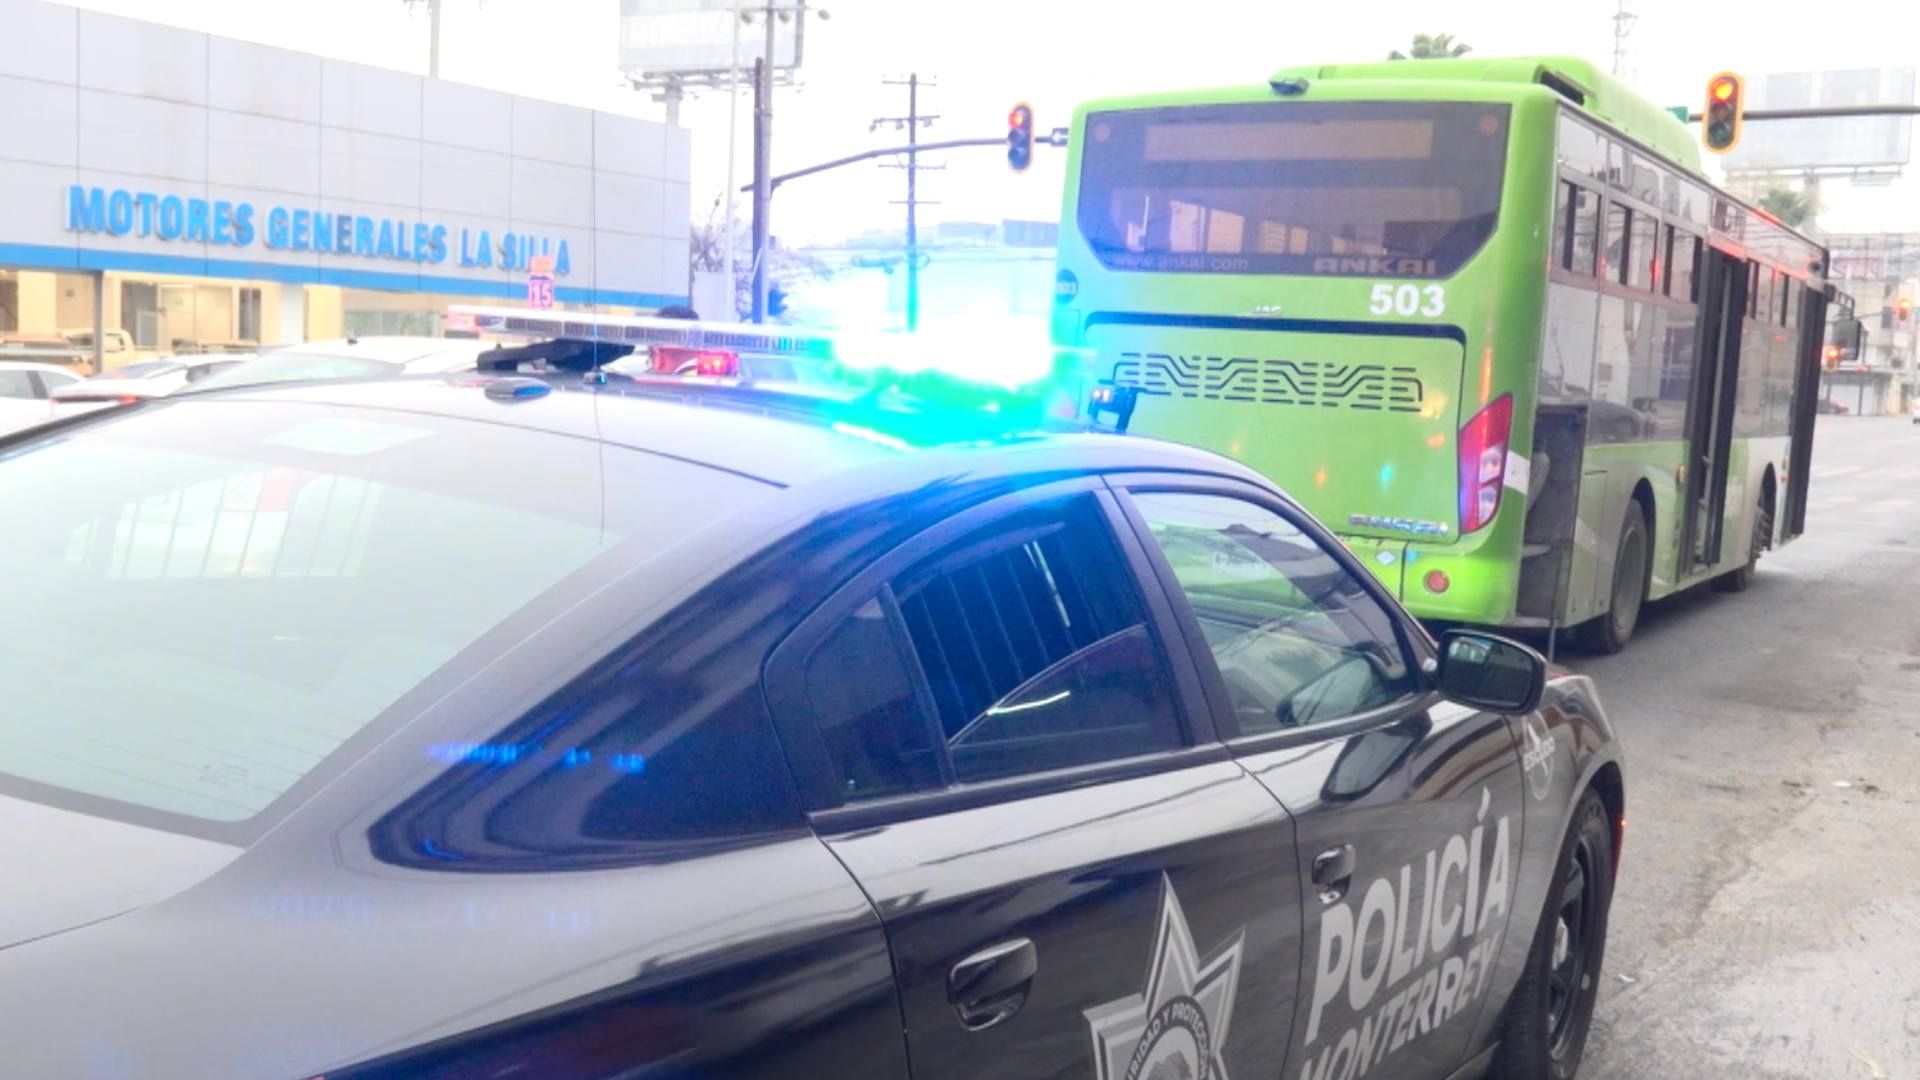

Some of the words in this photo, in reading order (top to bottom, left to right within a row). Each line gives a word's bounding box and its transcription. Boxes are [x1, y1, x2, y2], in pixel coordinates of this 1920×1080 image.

[68, 184, 255, 246] MOTORES
[266, 206, 447, 265] GENERALES
[460, 228, 494, 269] LA
[1313, 257, 1436, 275] ANKAI
[1369, 283, 1446, 318] 503
[1304, 786, 1510, 1048] POLICÍA
[1162, 1006, 1171, 1026] Y
